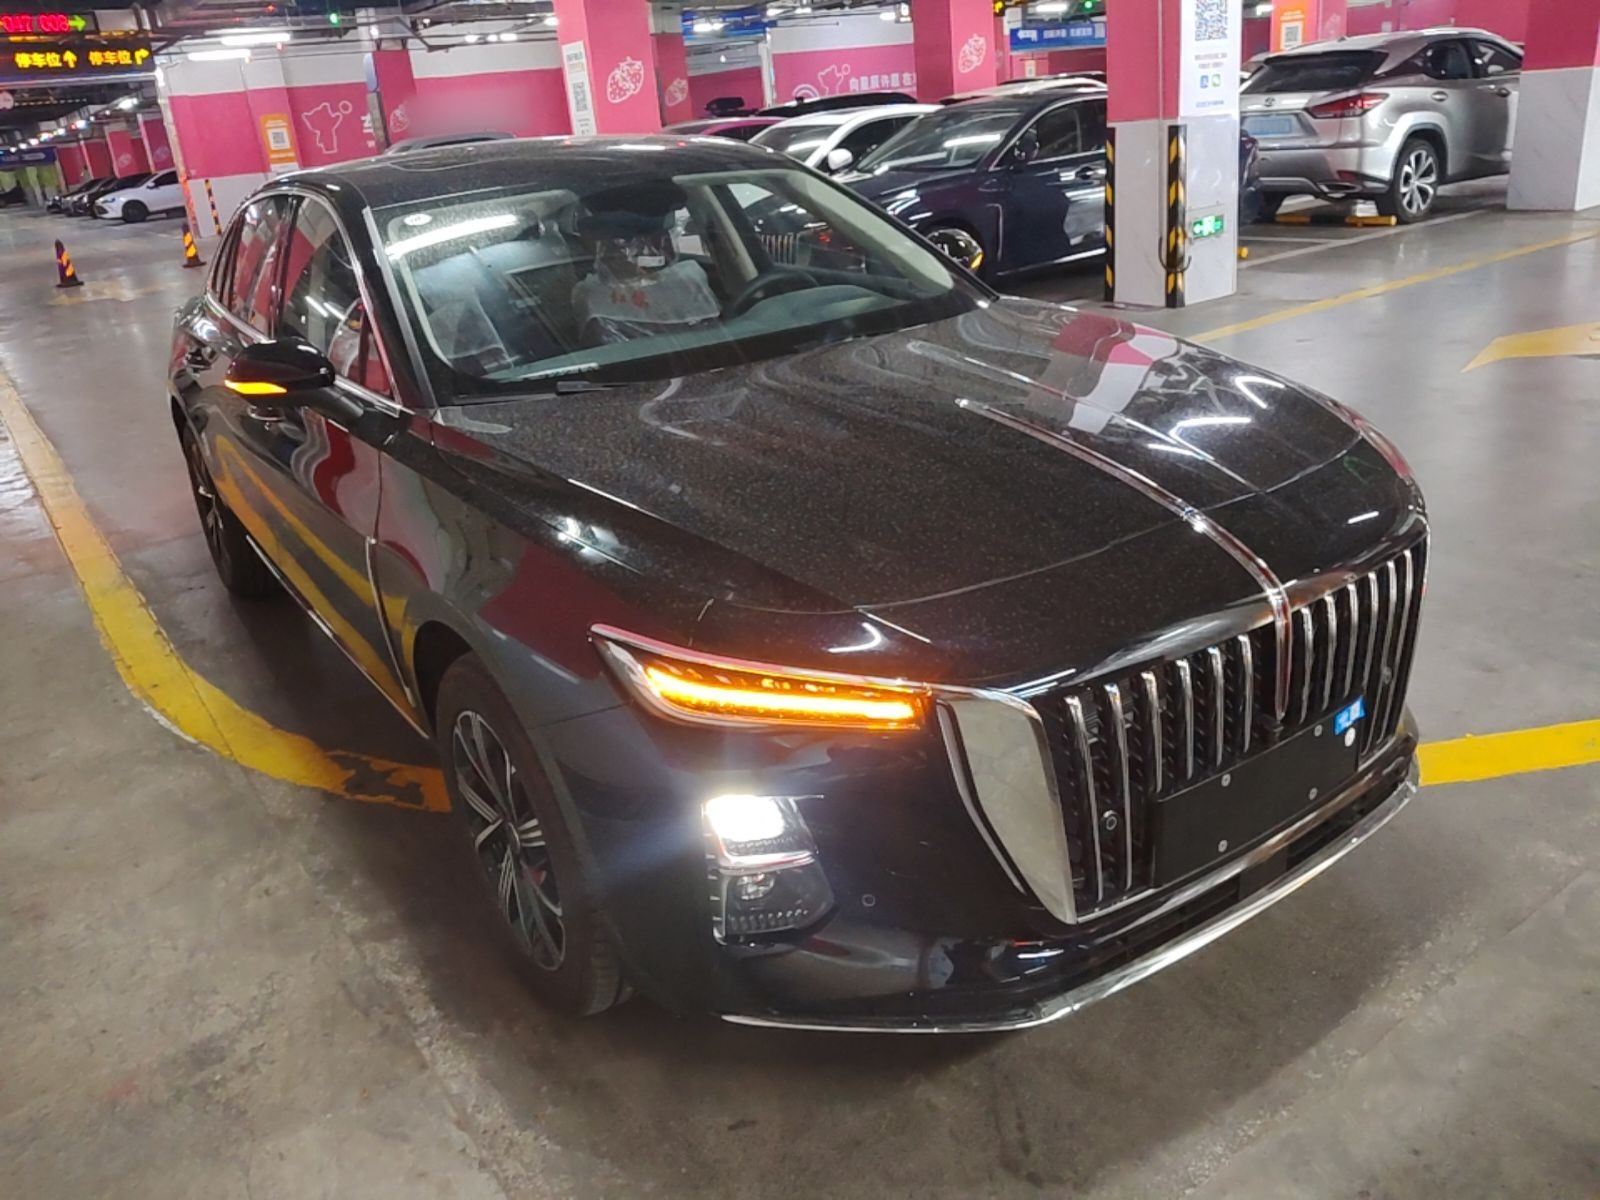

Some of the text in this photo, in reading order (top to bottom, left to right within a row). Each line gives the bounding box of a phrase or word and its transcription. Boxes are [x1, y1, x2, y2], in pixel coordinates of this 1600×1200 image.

[15, 50, 132, 68] 停车位 停车位
